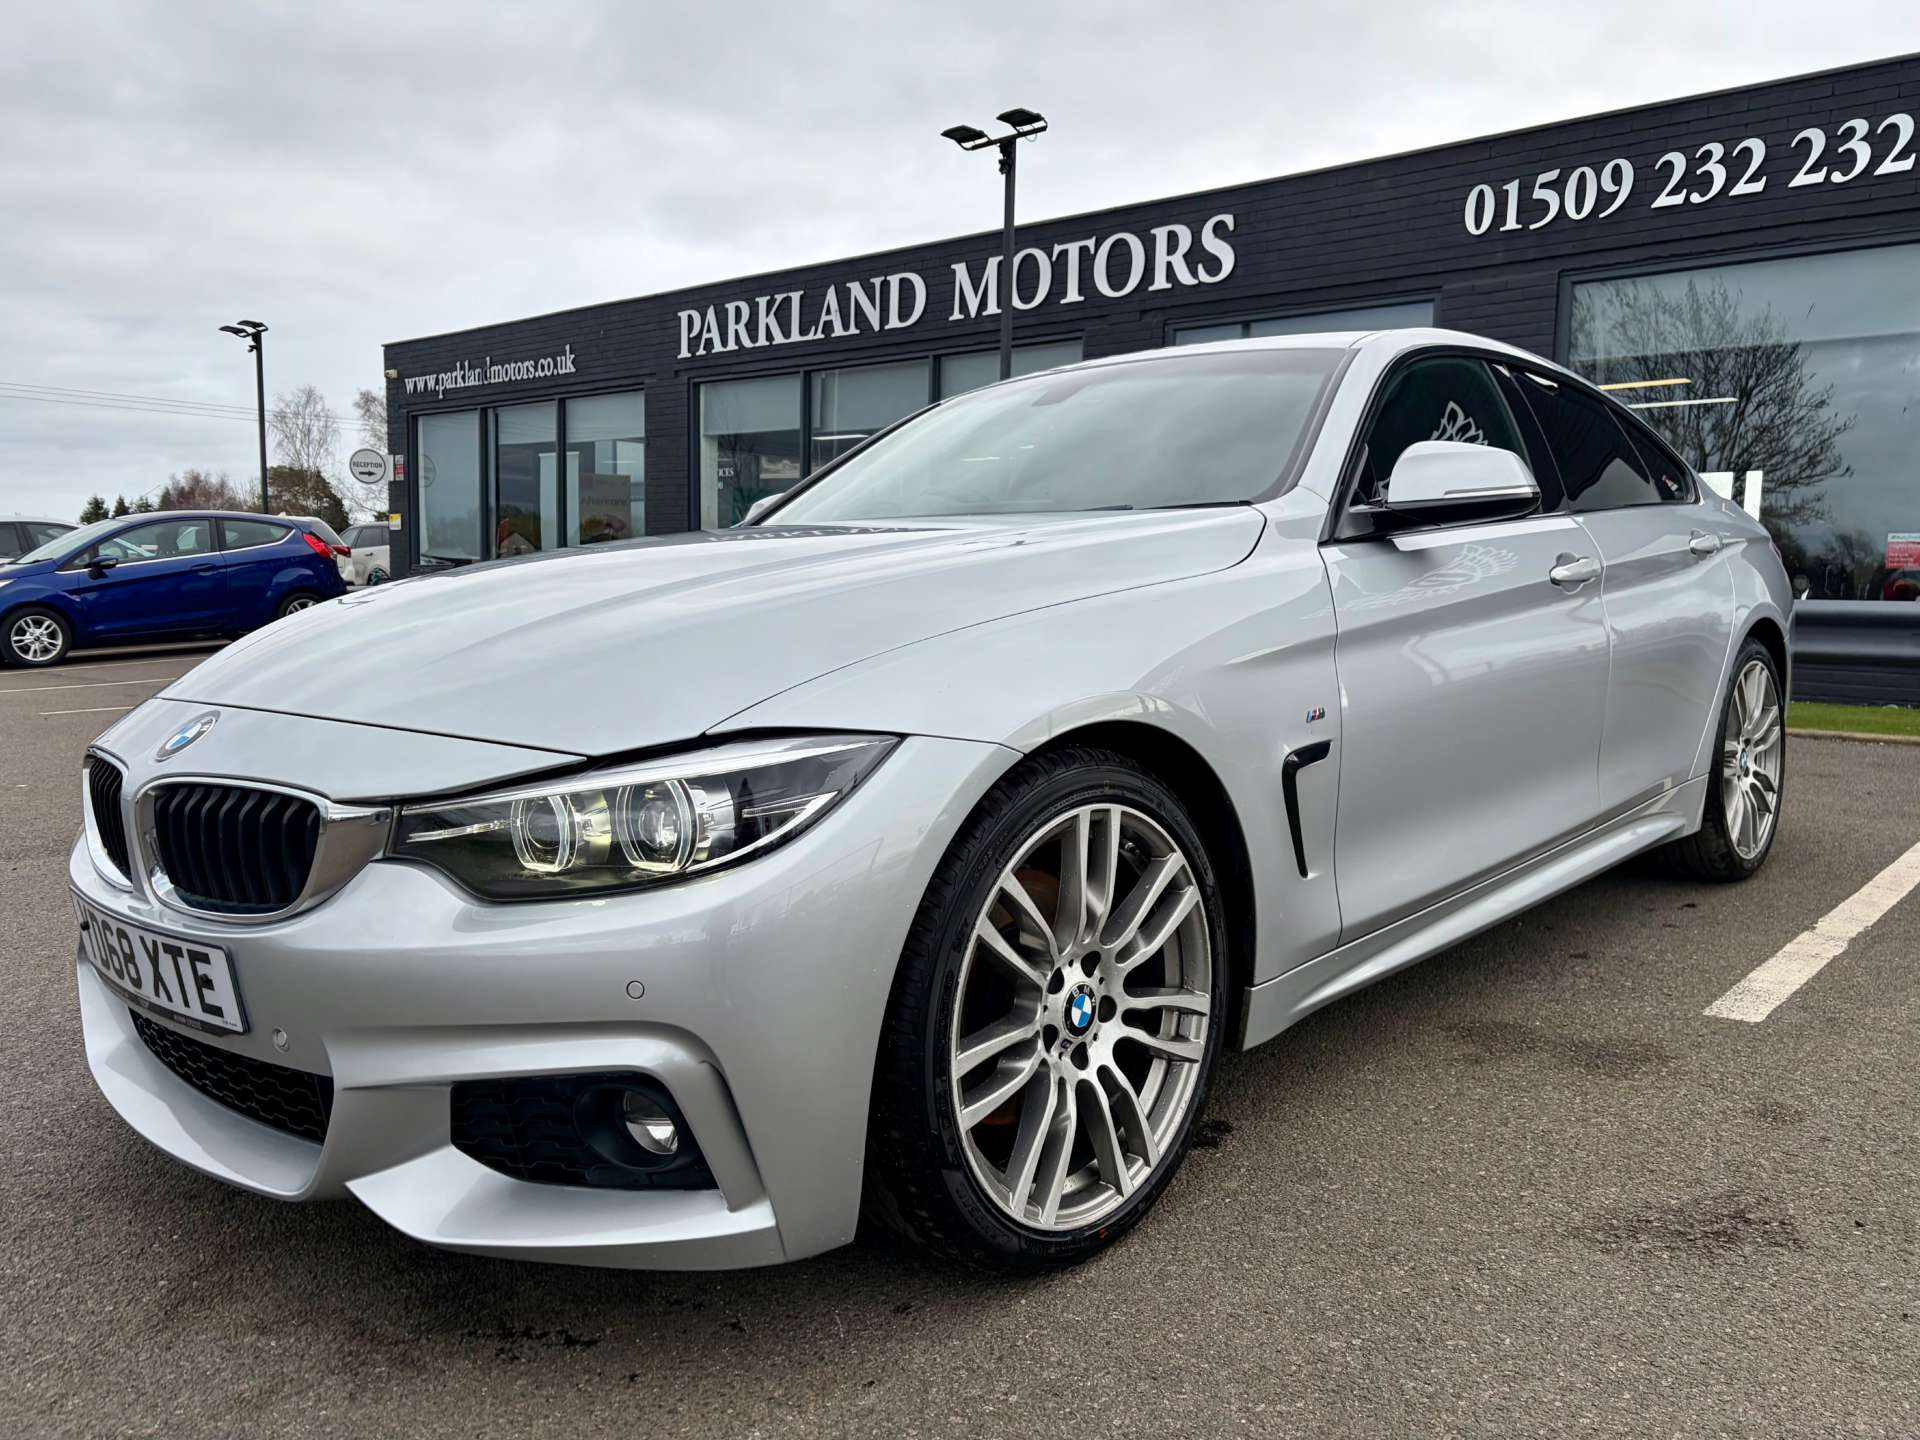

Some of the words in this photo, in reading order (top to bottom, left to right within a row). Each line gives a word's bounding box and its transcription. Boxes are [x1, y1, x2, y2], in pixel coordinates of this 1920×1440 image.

[1464, 158, 1634, 236] 01509
[1651, 138, 1768, 209] 232
[1788, 113, 1915, 189] 232
[677, 272, 927, 359] PARKLAND
[949, 214, 1236, 320] MOTORS
[404, 344, 576, 399] www.parklandmotors.co.uk
[353, 461, 382, 469] RECEPTION
[139, 935, 224, 1019] XTE
